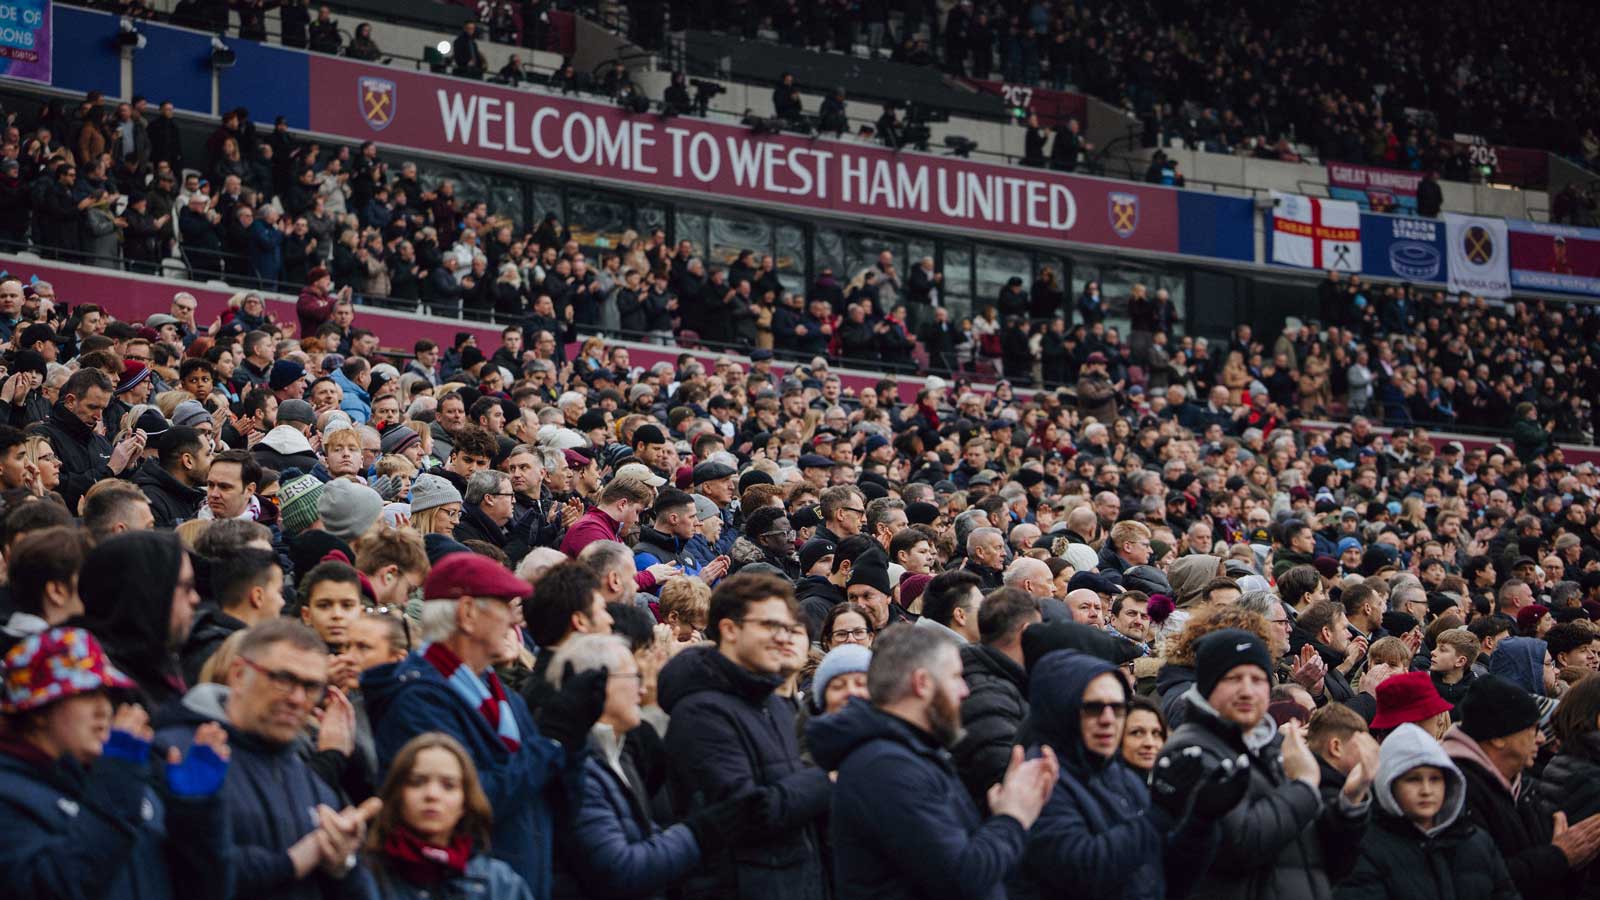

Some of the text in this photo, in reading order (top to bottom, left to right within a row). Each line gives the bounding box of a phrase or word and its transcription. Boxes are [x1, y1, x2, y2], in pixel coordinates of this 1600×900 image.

[23, 9, 42, 25] OF
[437, 89, 1077, 230] WELCOME TO WEST HAM UNITED
[1331, 166, 1423, 190] GREAT YARMOUT
[1315, 226, 1358, 241] VILLAGE
[1391, 219, 1436, 233] LONDON
[1392, 229, 1437, 242] STADIUM
